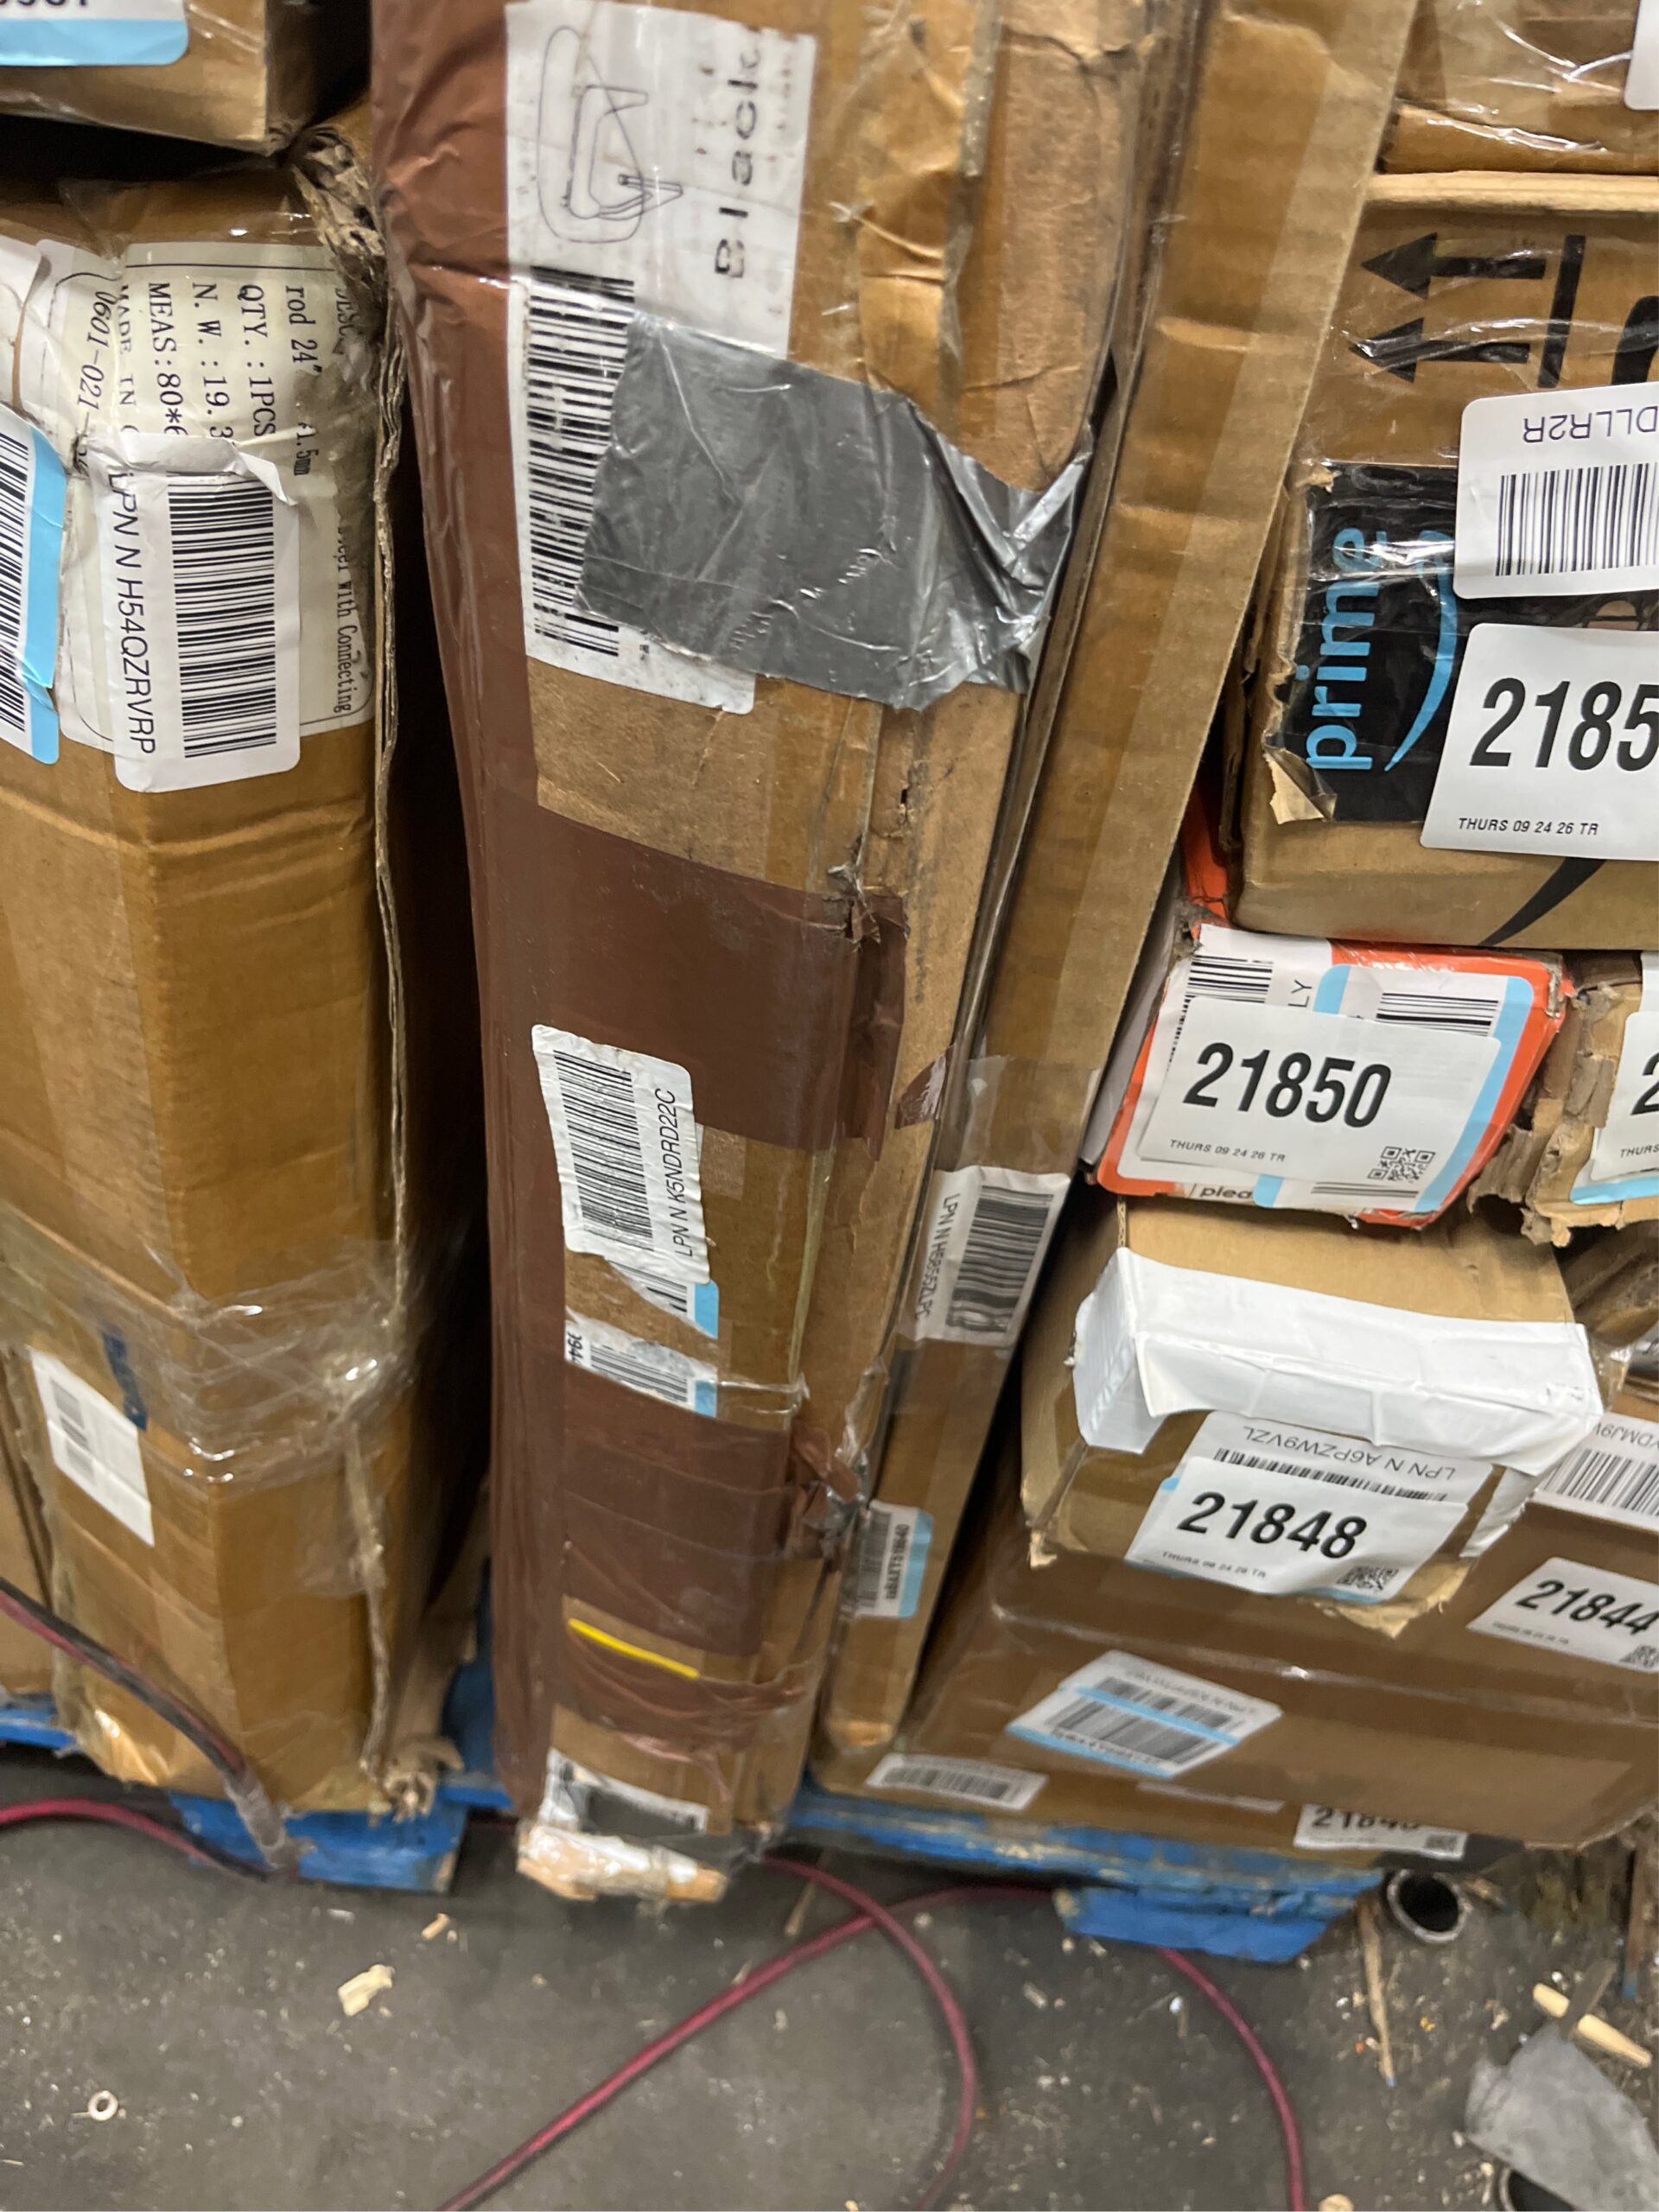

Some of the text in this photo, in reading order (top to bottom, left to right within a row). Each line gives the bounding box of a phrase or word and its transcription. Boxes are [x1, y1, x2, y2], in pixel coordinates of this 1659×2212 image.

[286, 285, 316, 325] rod
[1523, 405, 1659, 443] DLLR2R
[108, 473, 156, 754] LPN N H54QZRVRP
[334, 625, 358, 714] Connecting
[1295, 528, 1387, 769] prime
[1469, 677, 1659, 772] 2185
[1458, 817, 1599, 836] THURS 09 24 26 TR
[1183, 1042, 1392, 1128] 21850
[654, 1088, 693, 1257] LPN N K5NDRD22C
[1170, 1140, 1212, 1153] THURS
[1232, 1147, 1248, 1158] 24
[1269, 1152, 1286, 1162] TR
[1243, 1426, 1456, 1480] LPN N A6PZW9VZL
[1176, 1491, 1366, 1559] 21848
[1516, 1580, 1659, 1636] 21844
